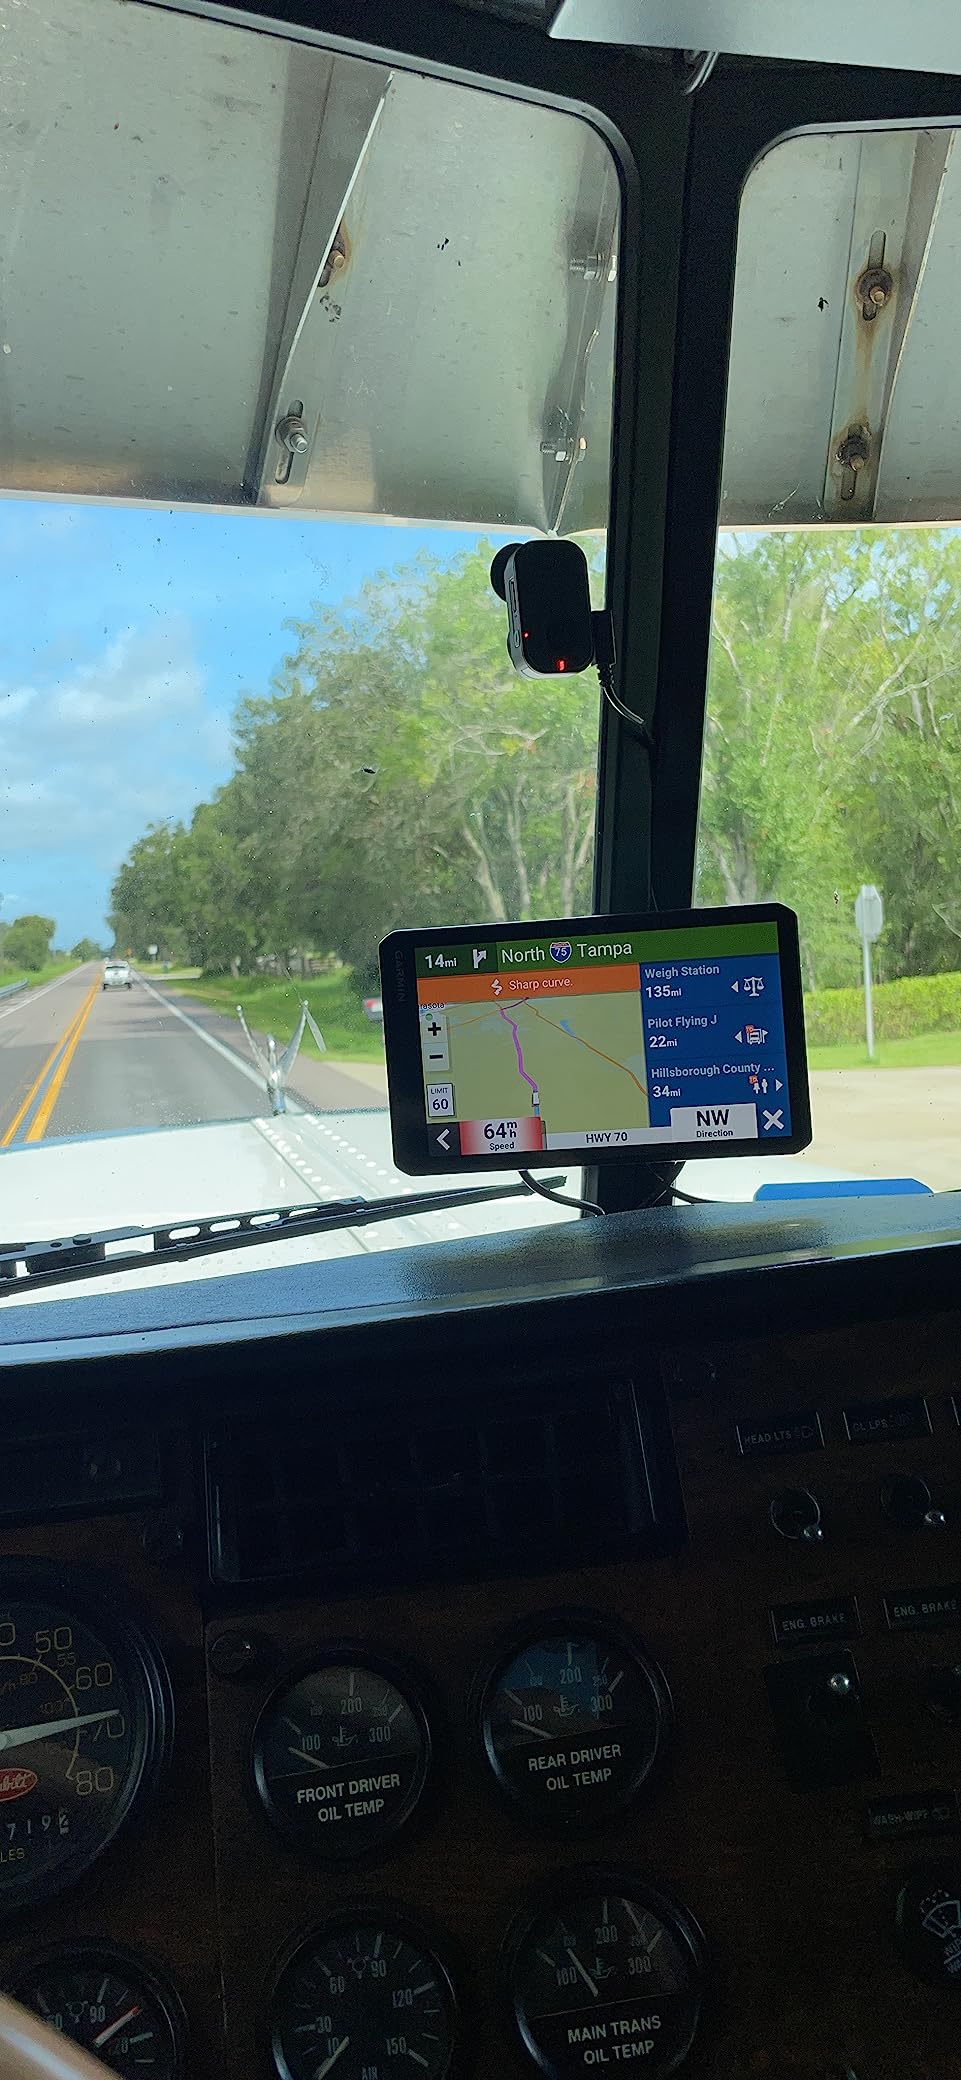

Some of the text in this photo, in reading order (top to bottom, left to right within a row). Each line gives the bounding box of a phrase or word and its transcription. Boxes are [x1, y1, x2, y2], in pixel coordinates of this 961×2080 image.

[425, 943, 632, 969] 14mi North 75 Tampa
[394, 950, 407, 1003] GARMIN
[645, 965, 720, 980] Weigh Station
[509, 978, 573, 991] Sharp curve.
[645, 985, 682, 998] 135mi
[647, 1015, 717, 1029] Pilot Flying J
[649, 1036, 678, 1048] 22mi
[651, 1065, 720, 1078] Hillsborough
[722, 1063, 761, 1075] County
[430, 1087, 449, 1095] LIMIT
[652, 1085, 681, 1098] 34mi
[432, 1098, 449, 1110] 60
[696, 1109, 730, 1127] NW
[483, 1122, 508, 1140] 64
[586, 1132, 628, 1144] HWY 70
[696, 1129, 734, 1138] Direction
[489, 1141, 515, 1152] Speed
[744, 1430, 792, 1445] HEAD LTS
[894, 1600, 958, 1617] ENG. BRAKE
[782, 1613, 848, 1632] ENG. BRAKE
[35, 1626, 72, 1653] 50
[57, 1653, 77, 1667] 55
[76, 1662, 113, 1690] 60
[560, 1666, 583, 1684] 200
[340, 1696, 363, 1715] 200
[590, 1694, 613, 1712] 300
[522, 1703, 543, 1722] 100
[301, 1734, 321, 1751] 100
[368, 1726, 391, 1743] 300
[528, 1743, 622, 1771] REAR DRIVER
[76, 1766, 114, 1796] 80
[546, 1767, 612, 1791] OIL TEMP
[296, 1773, 401, 1804] FRONT DRIVER
[317, 1798, 385, 1823] OIL TEMP
[594, 1925, 618, 1944] 200
[370, 1959, 387, 1977] 90
[627, 1955, 652, 1975] 300
[329, 1976, 345, 1994] 60
[556, 1966, 577, 1987] 100
[391, 1988, 413, 2008] 120
[90, 2004, 106, 2023] 90
[316, 2015, 332, 2034] 30
[567, 2015, 662, 2045] MAIN TRANS
[386, 2036, 408, 2056] 150
[583, 2039, 655, 2065] OIL TEMP
